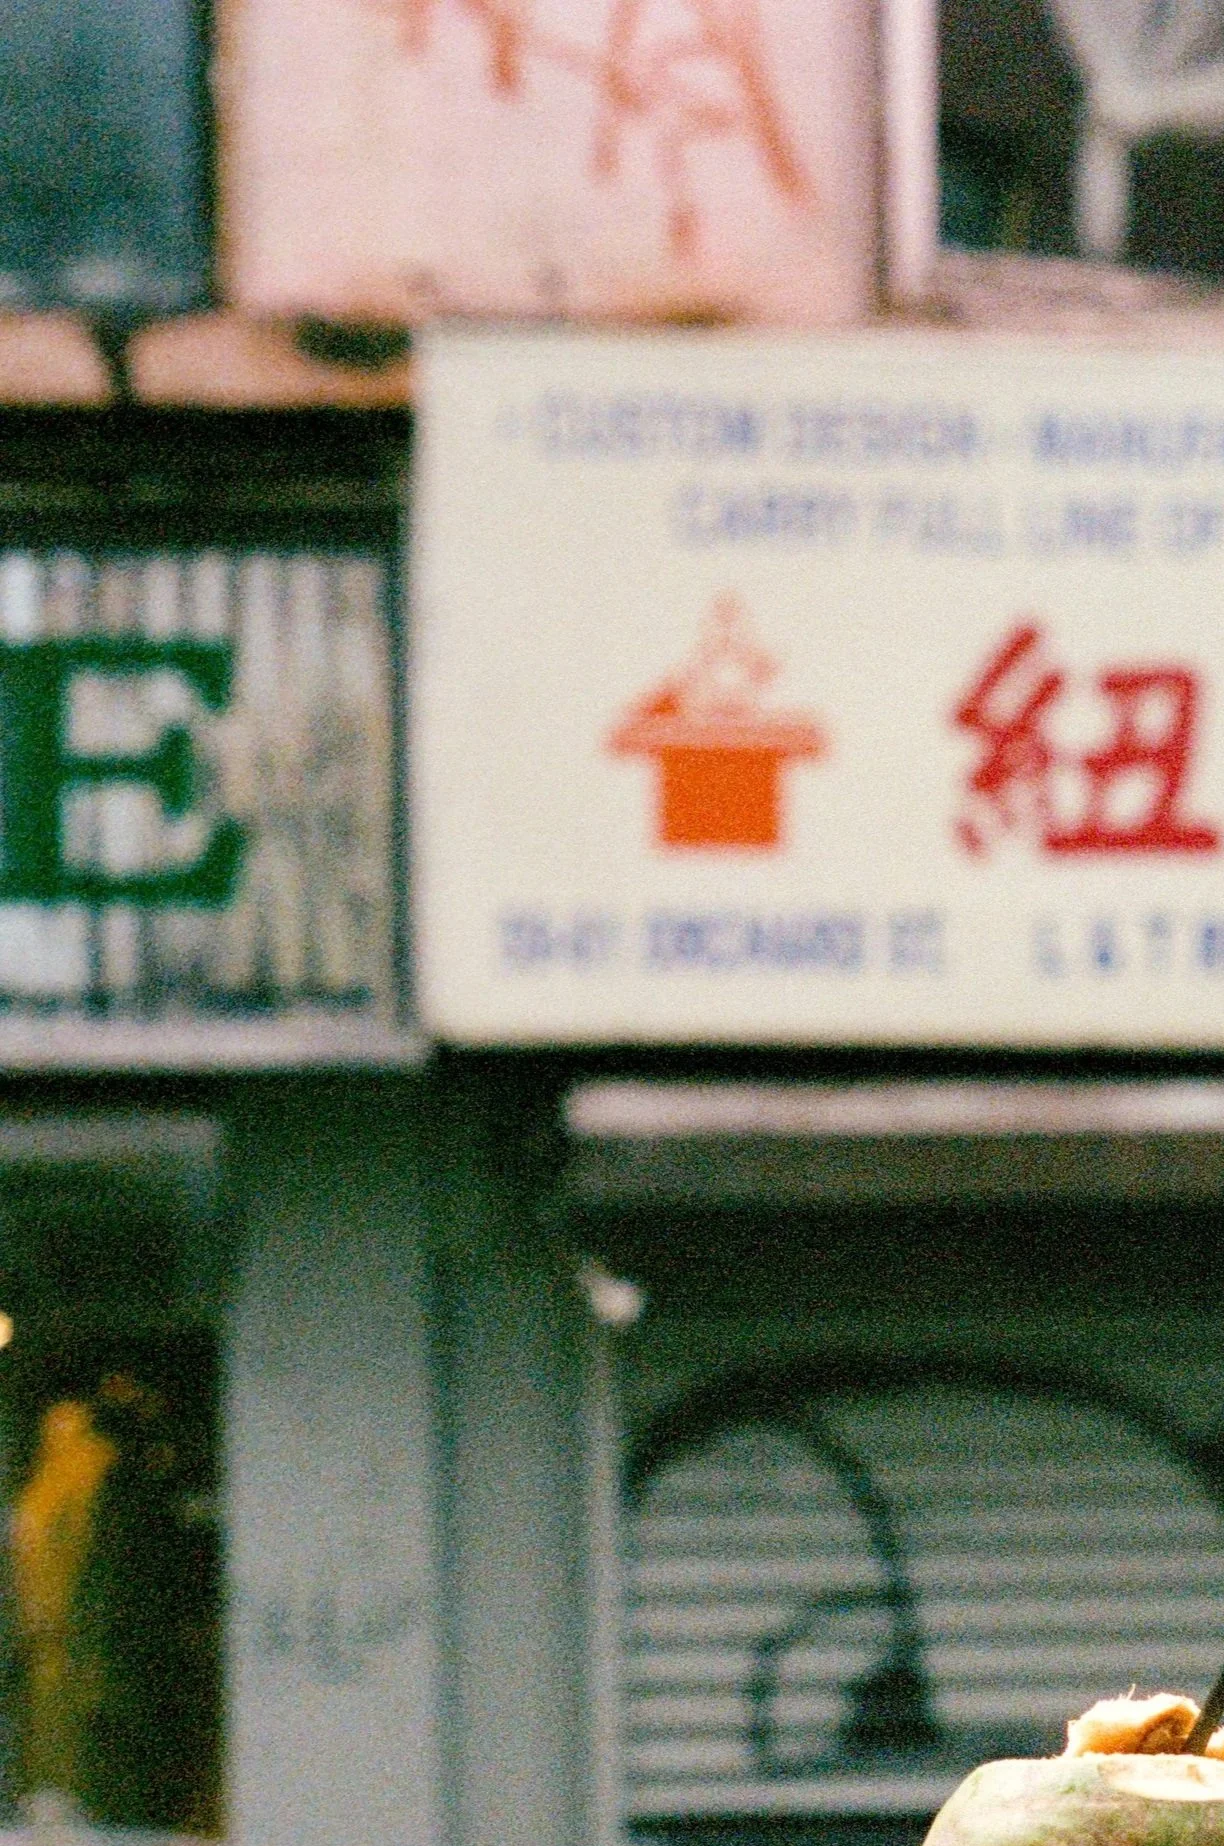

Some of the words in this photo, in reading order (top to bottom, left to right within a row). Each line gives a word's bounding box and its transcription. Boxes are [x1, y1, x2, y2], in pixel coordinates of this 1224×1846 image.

[535, 392, 764, 462] CUSTOM
[779, 400, 982, 466] DESIGN
[672, 484, 861, 548] CARRY
[876, 490, 1006, 554] FULL
[1022, 496, 1137, 556] LINE
[1160, 498, 1224, 558] OF
[640, 910, 870, 972] ORCHARD
[1034, 914, 1066, 978] L
[1143, 915, 1178, 978] T
